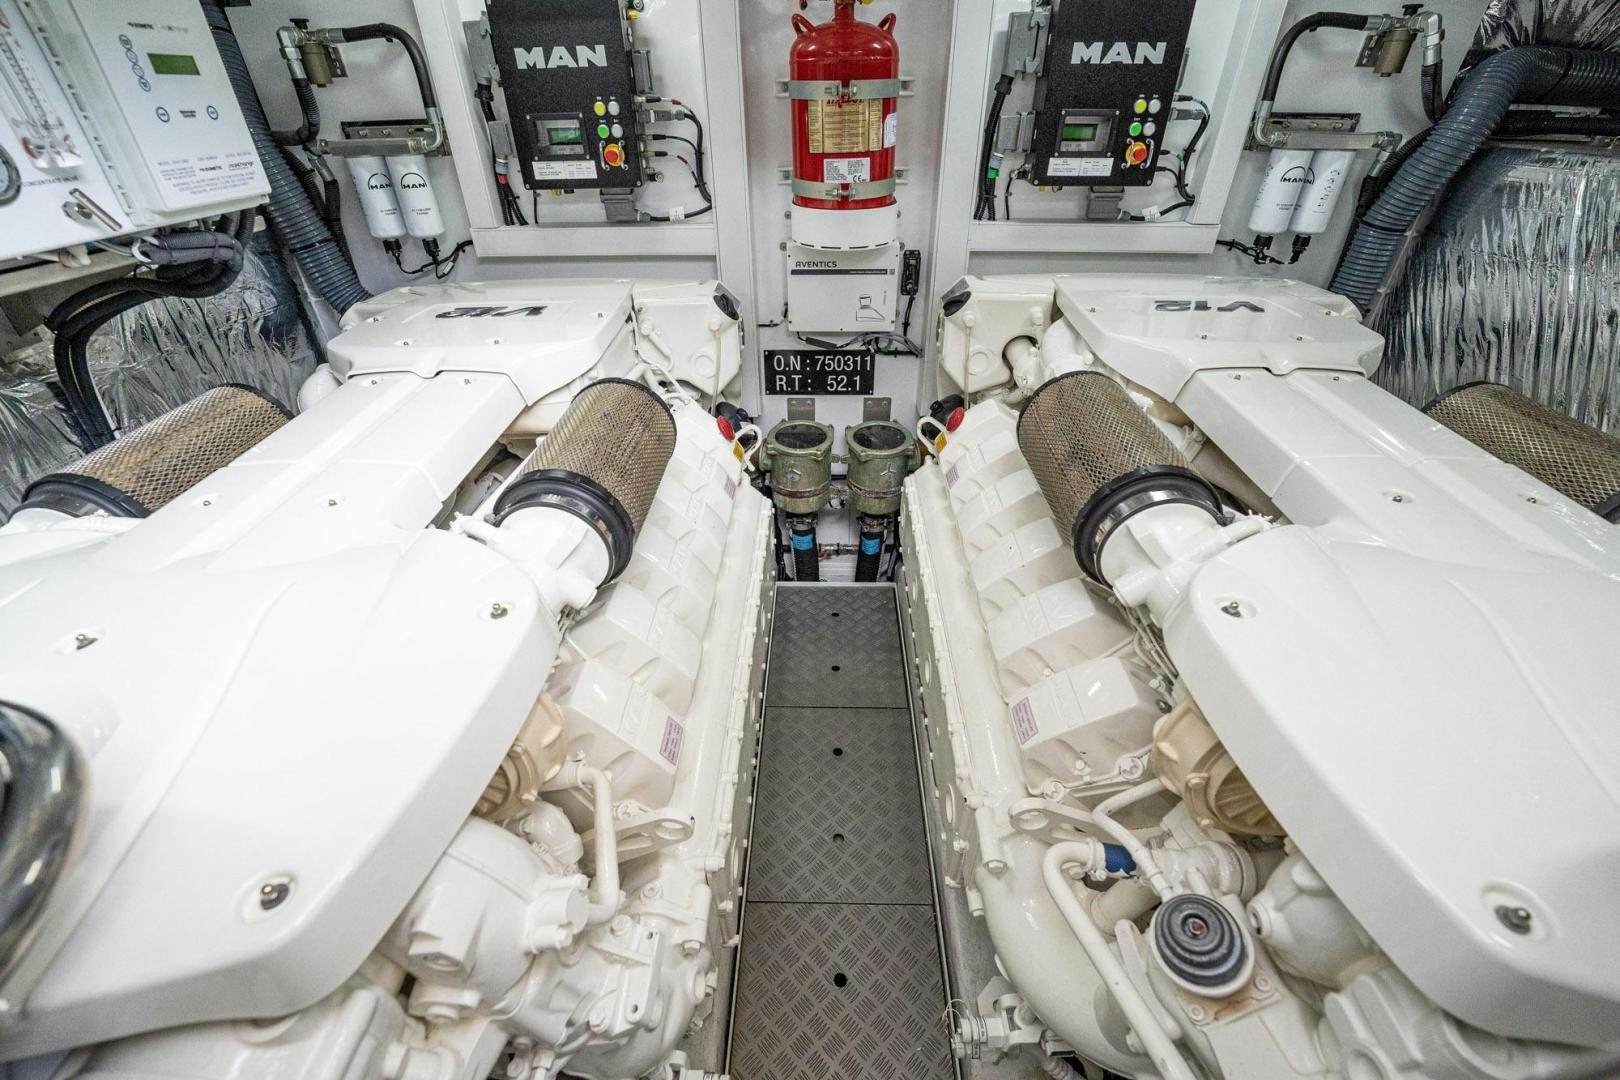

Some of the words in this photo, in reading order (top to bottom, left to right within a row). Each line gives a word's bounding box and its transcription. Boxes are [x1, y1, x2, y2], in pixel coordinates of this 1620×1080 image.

[514, 44, 608, 70] MAN
[1071, 41, 1167, 65] MAN
[795, 260, 838, 268] AVENTICS
[1154, 300, 1265, 312] V12
[814, 355, 872, 371] 750311
[826, 375, 861, 392] 52.1
